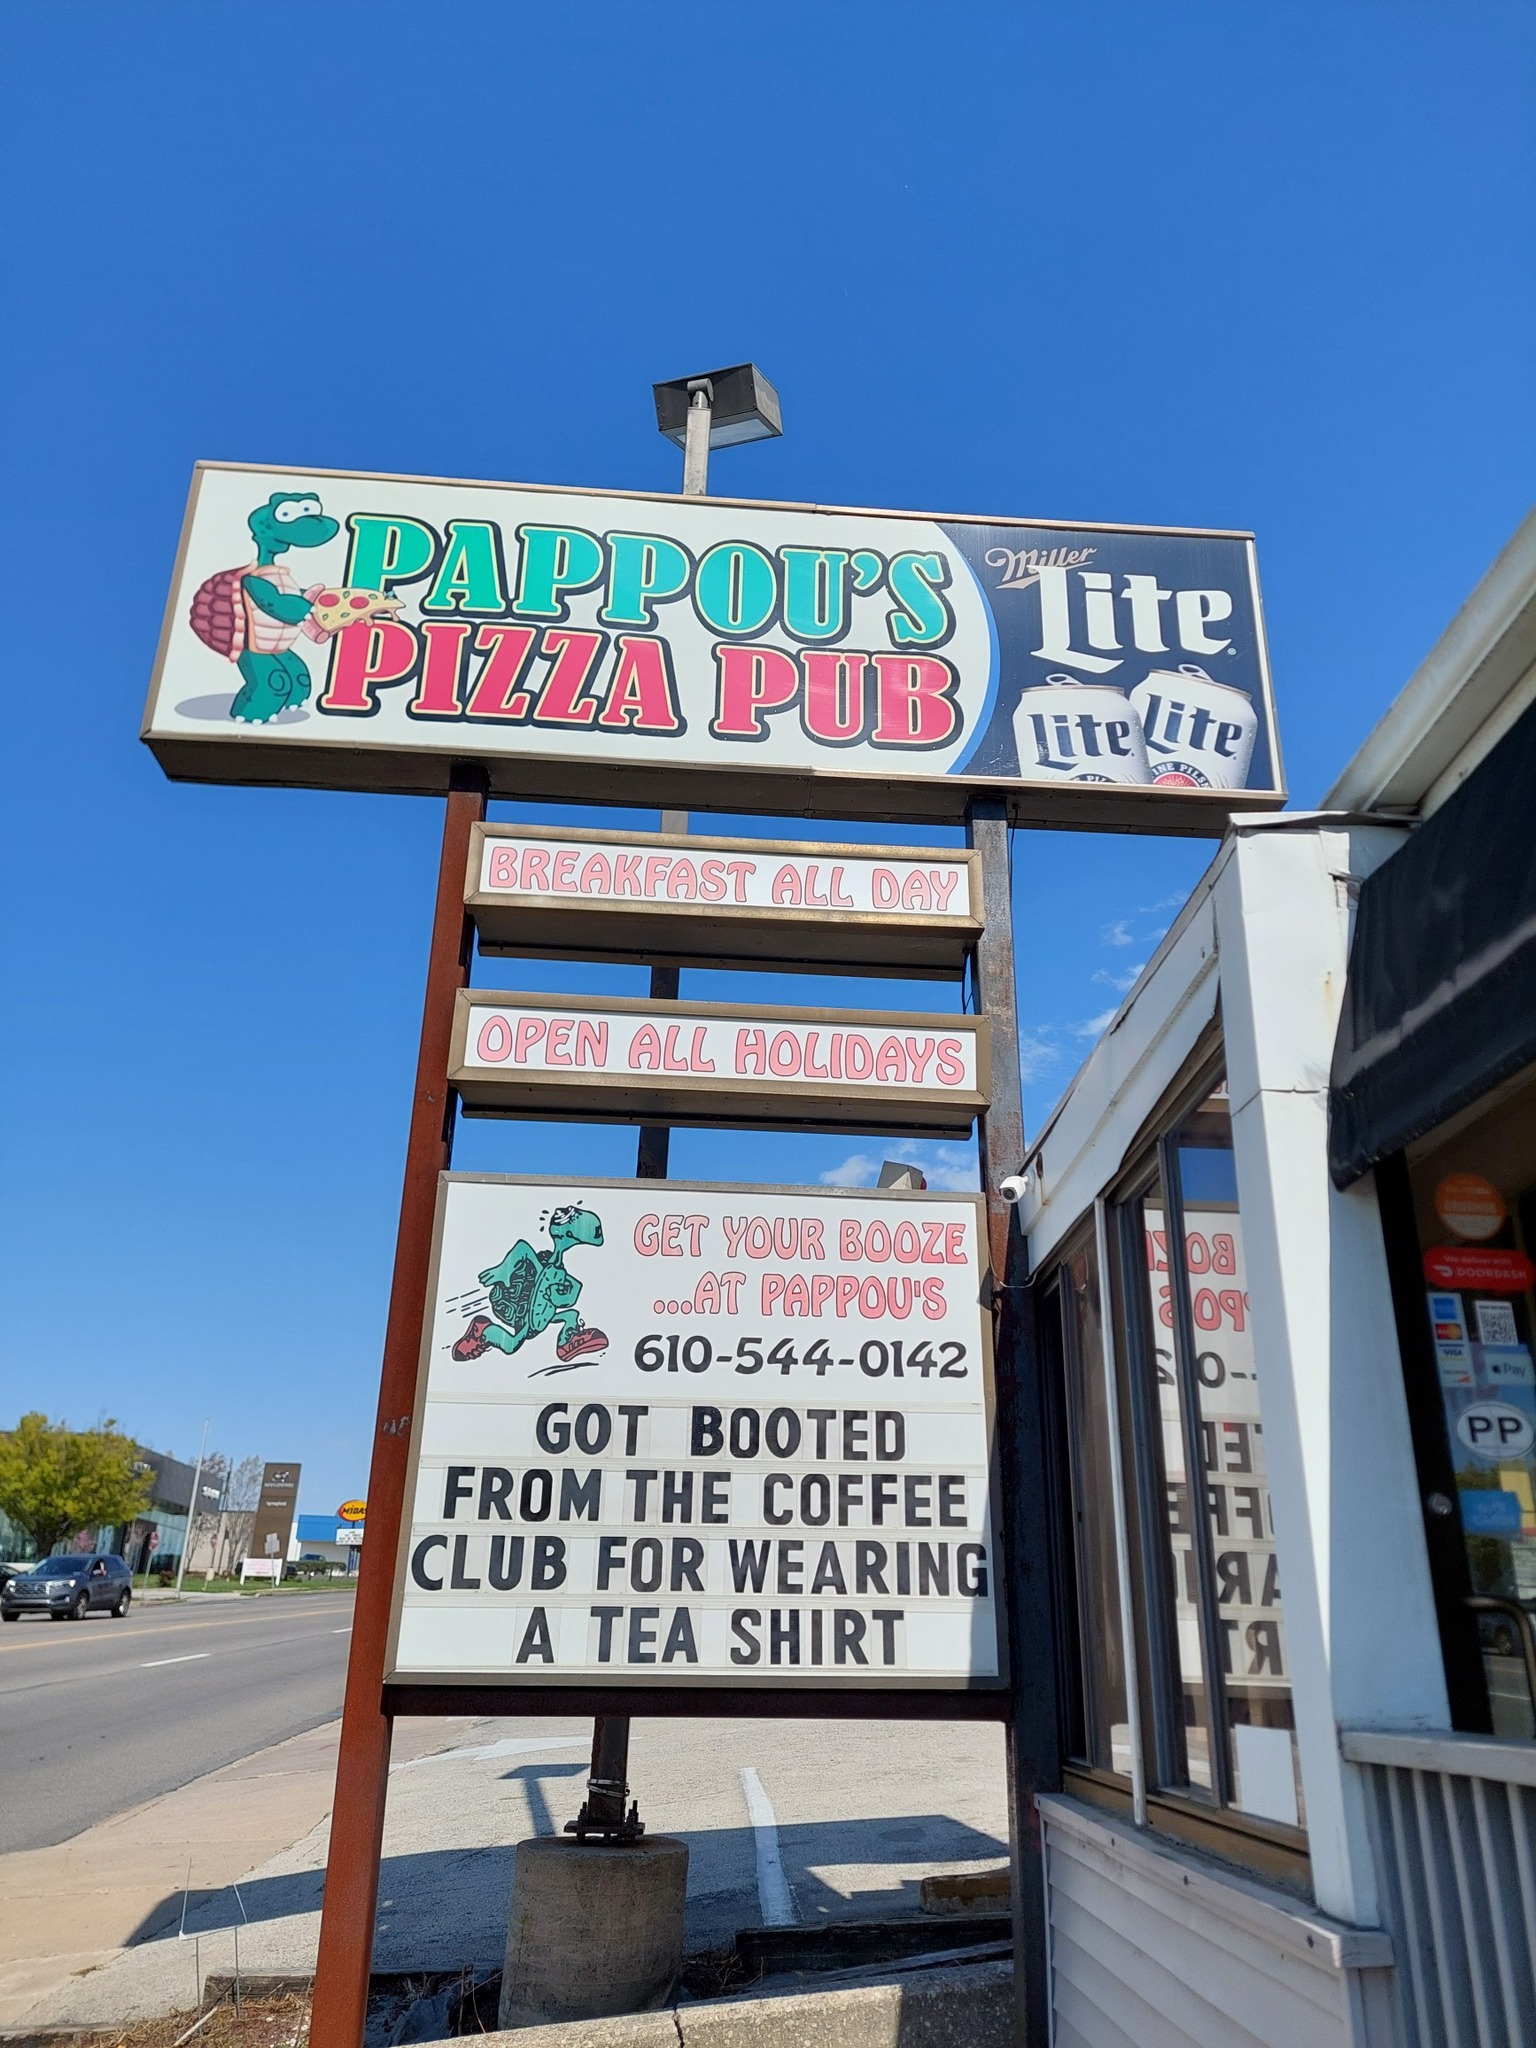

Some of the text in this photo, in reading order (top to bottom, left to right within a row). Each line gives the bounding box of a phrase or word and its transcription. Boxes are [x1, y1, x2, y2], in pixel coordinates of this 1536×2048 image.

[347, 512, 956, 649] PAPPOU'S
[984, 547, 1098, 589] Miller
[1027, 565, 1233, 674] Lite
[316, 620, 960, 749] PIZZA PUB
[1027, 713, 1132, 771] Lite
[1146, 692, 1243, 757] Lite
[489, 846, 958, 911] BREAKFAST ALL DAY
[477, 1015, 965, 1086] OPEN ALL HOLIDAYS
[633, 1214, 967, 1264] GET YOUR BOOZE
[761, 1274, 947, 1320] PAPPOU'S
[1457, 1267, 1527, 1279] DOORDASH
[634, 1334, 968, 1379] 610-544-0142
[1503, 1363, 1526, 1378] Pay
[536, 1403, 906, 1461] GOT BOOTED
[443, 1466, 967, 1527] FROM THE COFFEE
[411, 1535, 988, 1598] CLUB FOR WEARING
[515, 1606, 904, 1665] A TEA SHIRT
